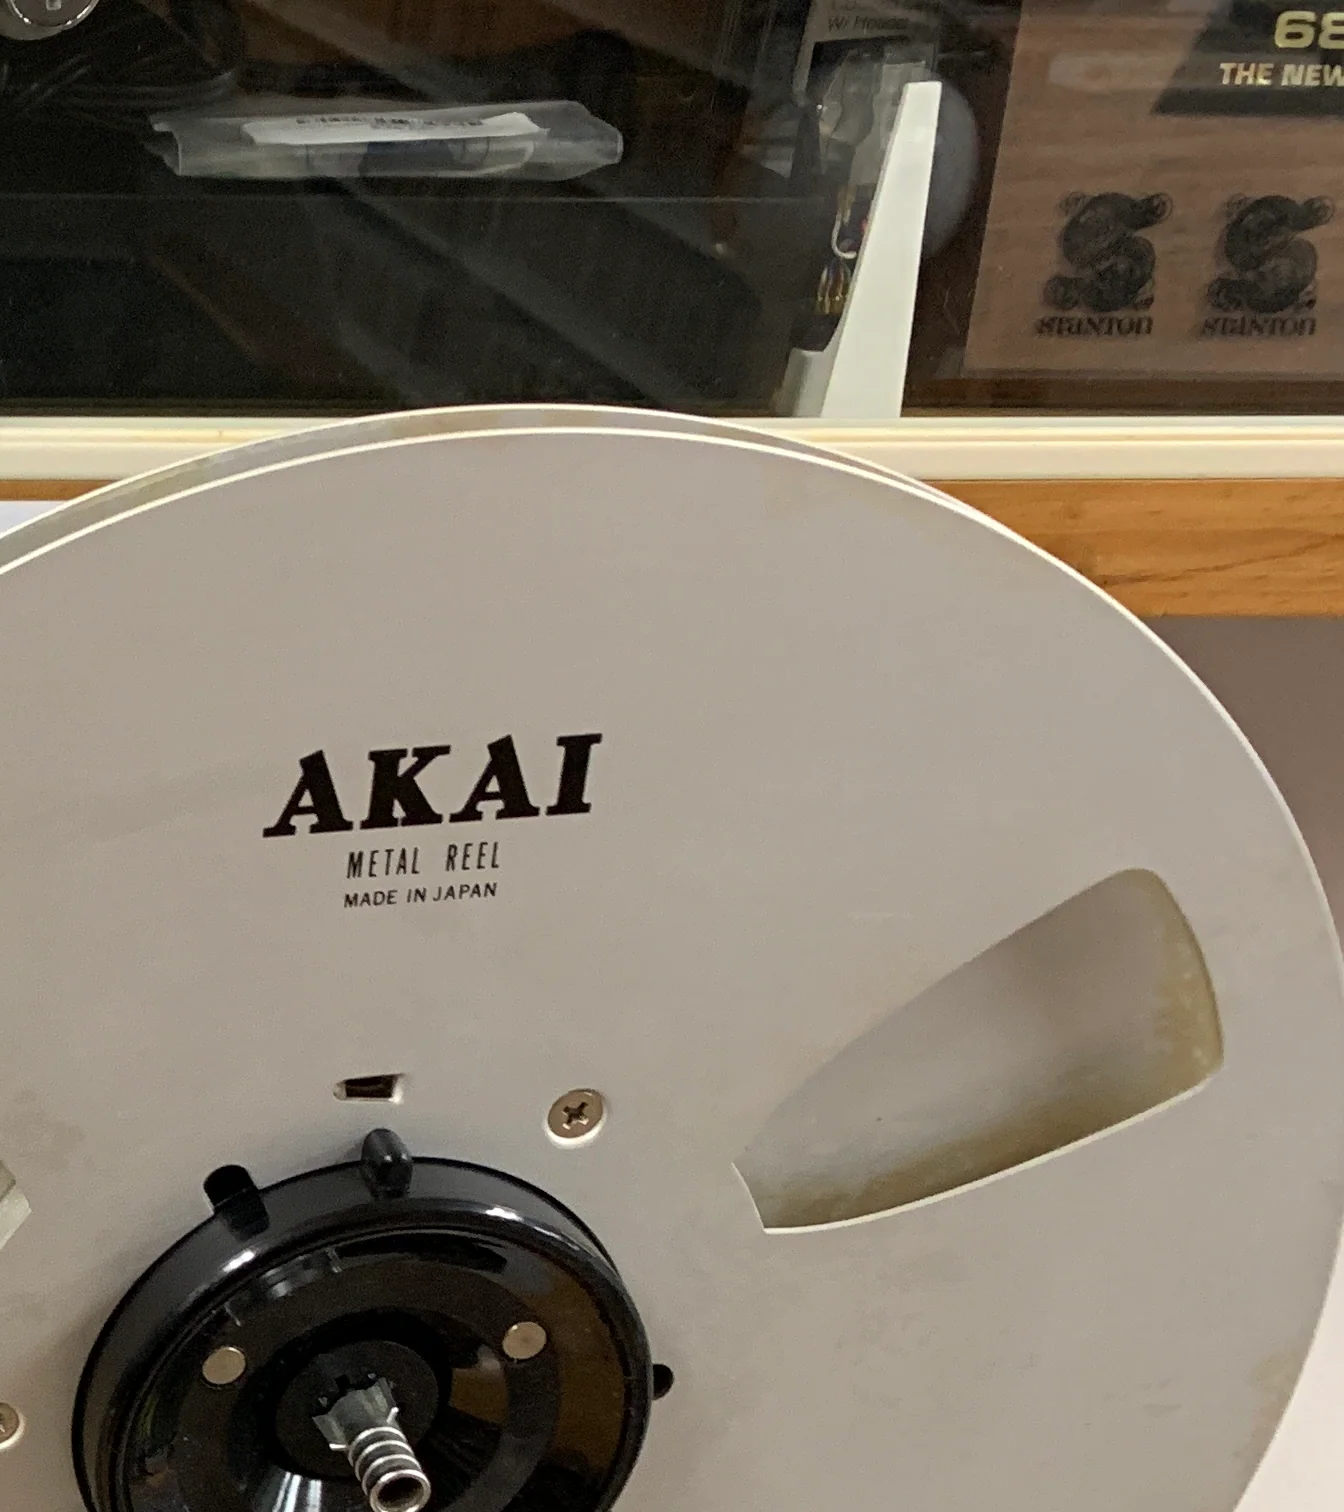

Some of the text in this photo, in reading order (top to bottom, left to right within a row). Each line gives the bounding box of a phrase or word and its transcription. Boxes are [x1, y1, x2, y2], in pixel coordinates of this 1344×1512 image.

[1219, 62, 1344, 87] THE NEW
[262, 733, 603, 838] AKAI
[345, 841, 500, 880] METAL REEL
[343, 881, 498, 909] MADE IN JAPAN
